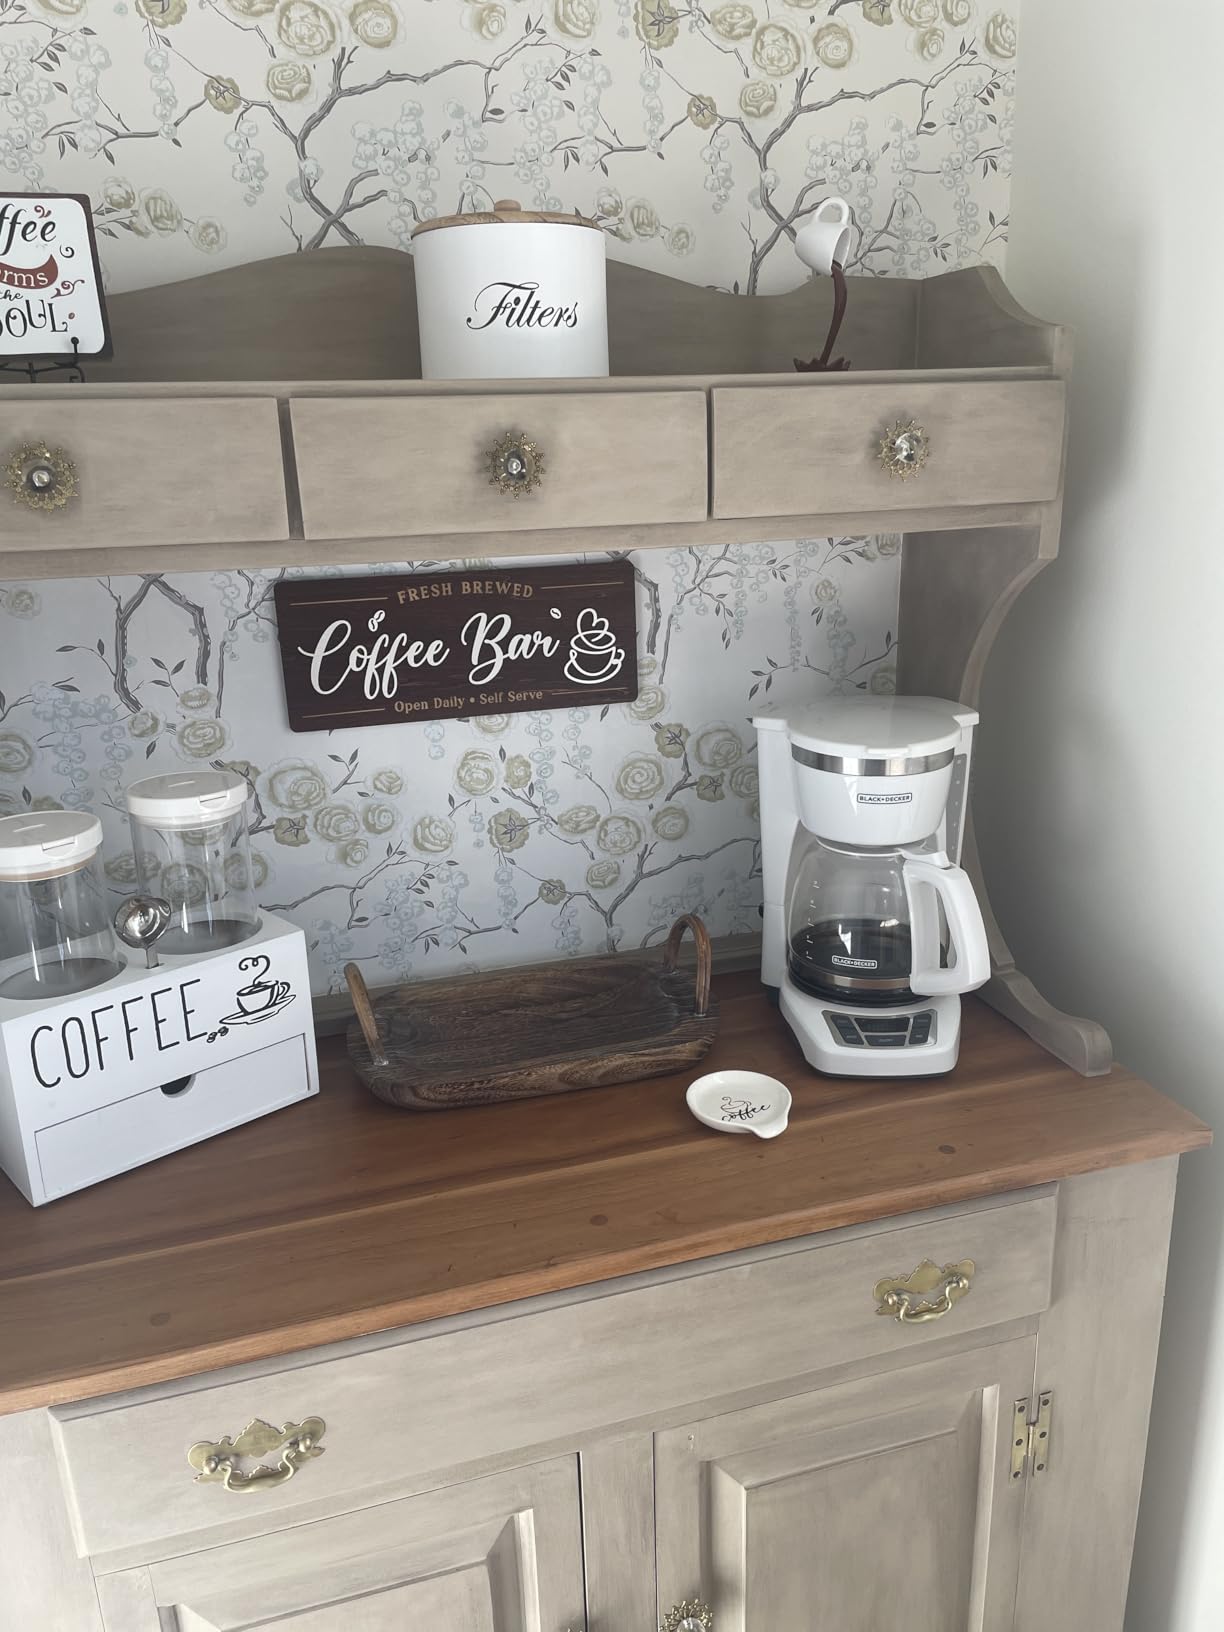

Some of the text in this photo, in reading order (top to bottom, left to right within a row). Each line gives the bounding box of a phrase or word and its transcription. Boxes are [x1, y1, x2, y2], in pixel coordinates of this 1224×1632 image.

[0, 269, 48, 287] rms
[0, 289, 24, 301] he
[466, 281, 578, 330] Filters
[0, 299, 68, 338] OUL
[397, 581, 534, 605] FRESH BREWED
[298, 612, 560, 700] Coffee Bar
[394, 690, 543, 714] Open Daily Self Serve
[30, 978, 208, 1088] COFFEE
